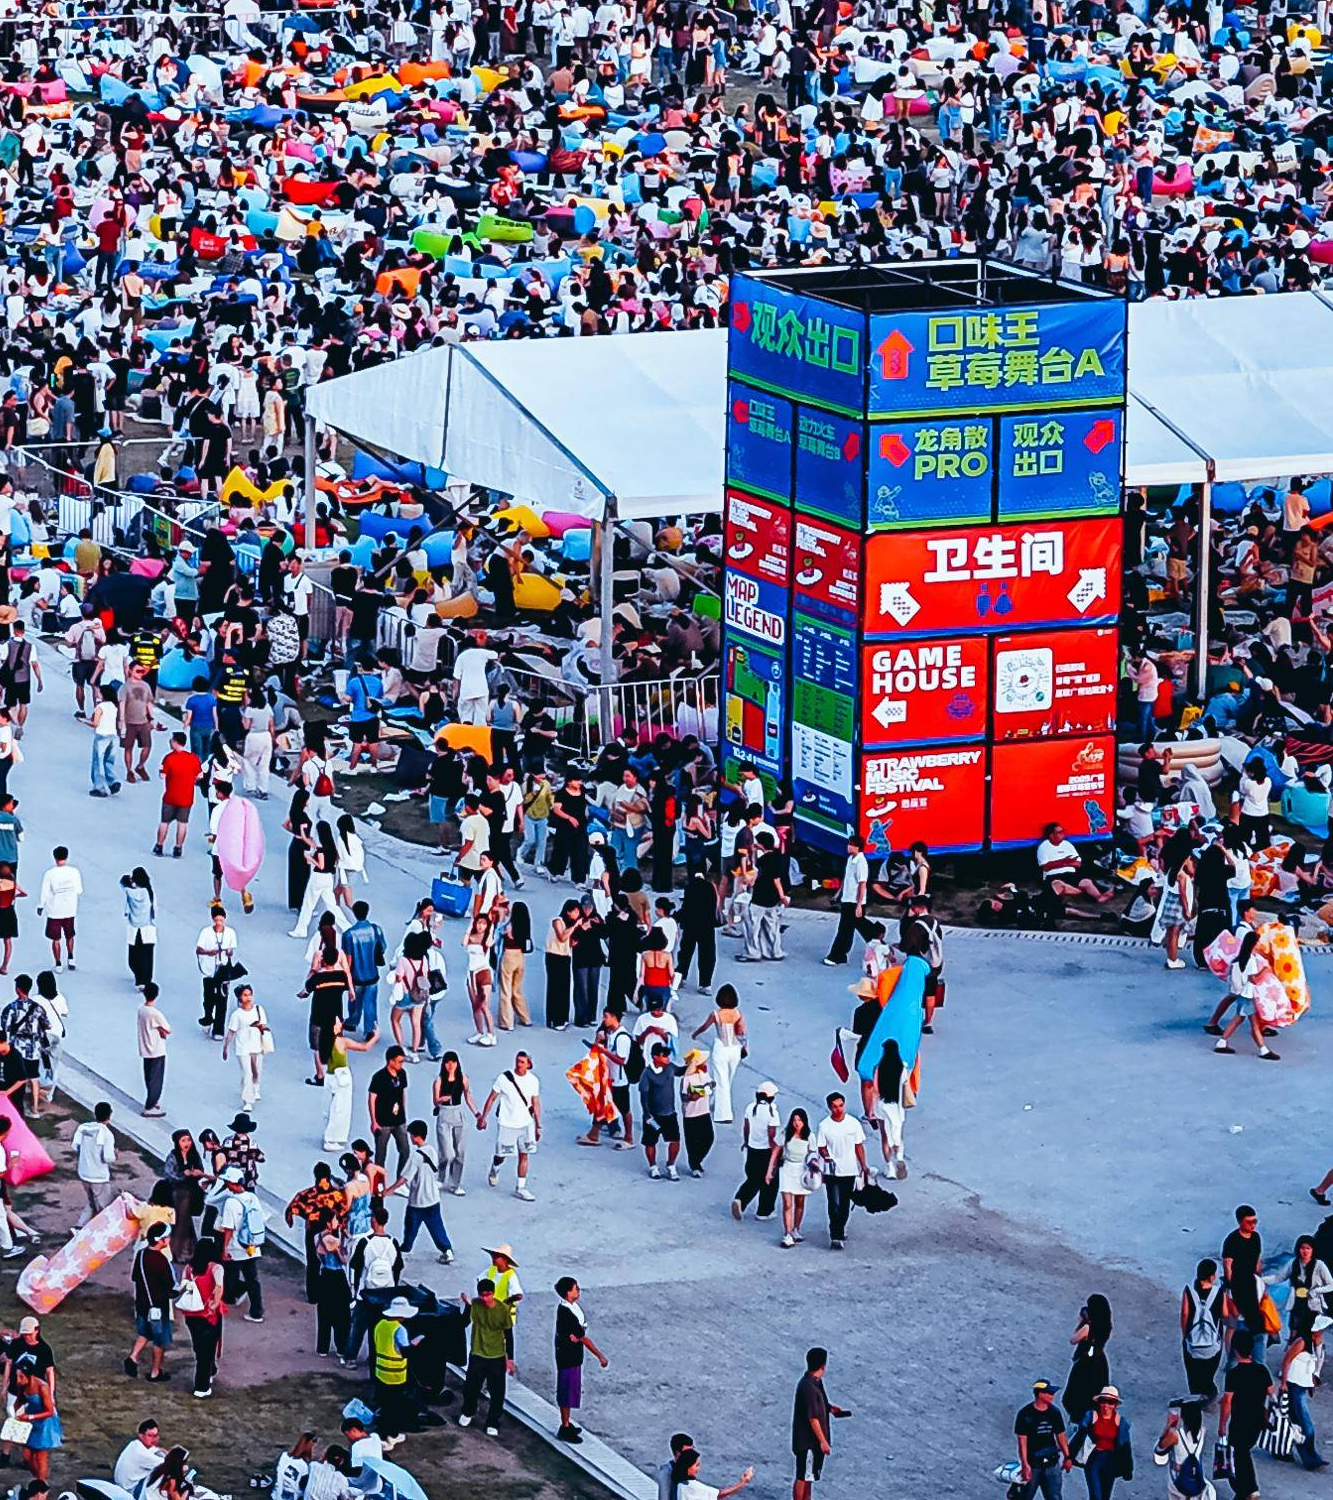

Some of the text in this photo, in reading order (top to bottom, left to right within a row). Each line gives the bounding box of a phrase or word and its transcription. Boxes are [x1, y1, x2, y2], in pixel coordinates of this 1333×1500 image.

[751, 301, 859, 375] 观众出口
[927, 311, 1040, 351] 口味王
[925, 346, 1105, 391] 草莓舞台A
[914, 425, 987, 453] 龙角散
[1012, 421, 1064, 448] 观众
[914, 451, 988, 480] PRO
[1013, 449, 1063, 477] 出口
[923, 531, 1064, 583] 卫生间
[726, 573, 757, 604] MAP
[725, 597, 783, 640] LEGEND
[872, 645, 962, 672] GAME
[872, 666, 976, 694] HOUSE
[866, 751, 982, 772] STRAWBERRY
[865, 768, 919, 784] MUSIC
[865, 778, 944, 796] FESTIVAL
